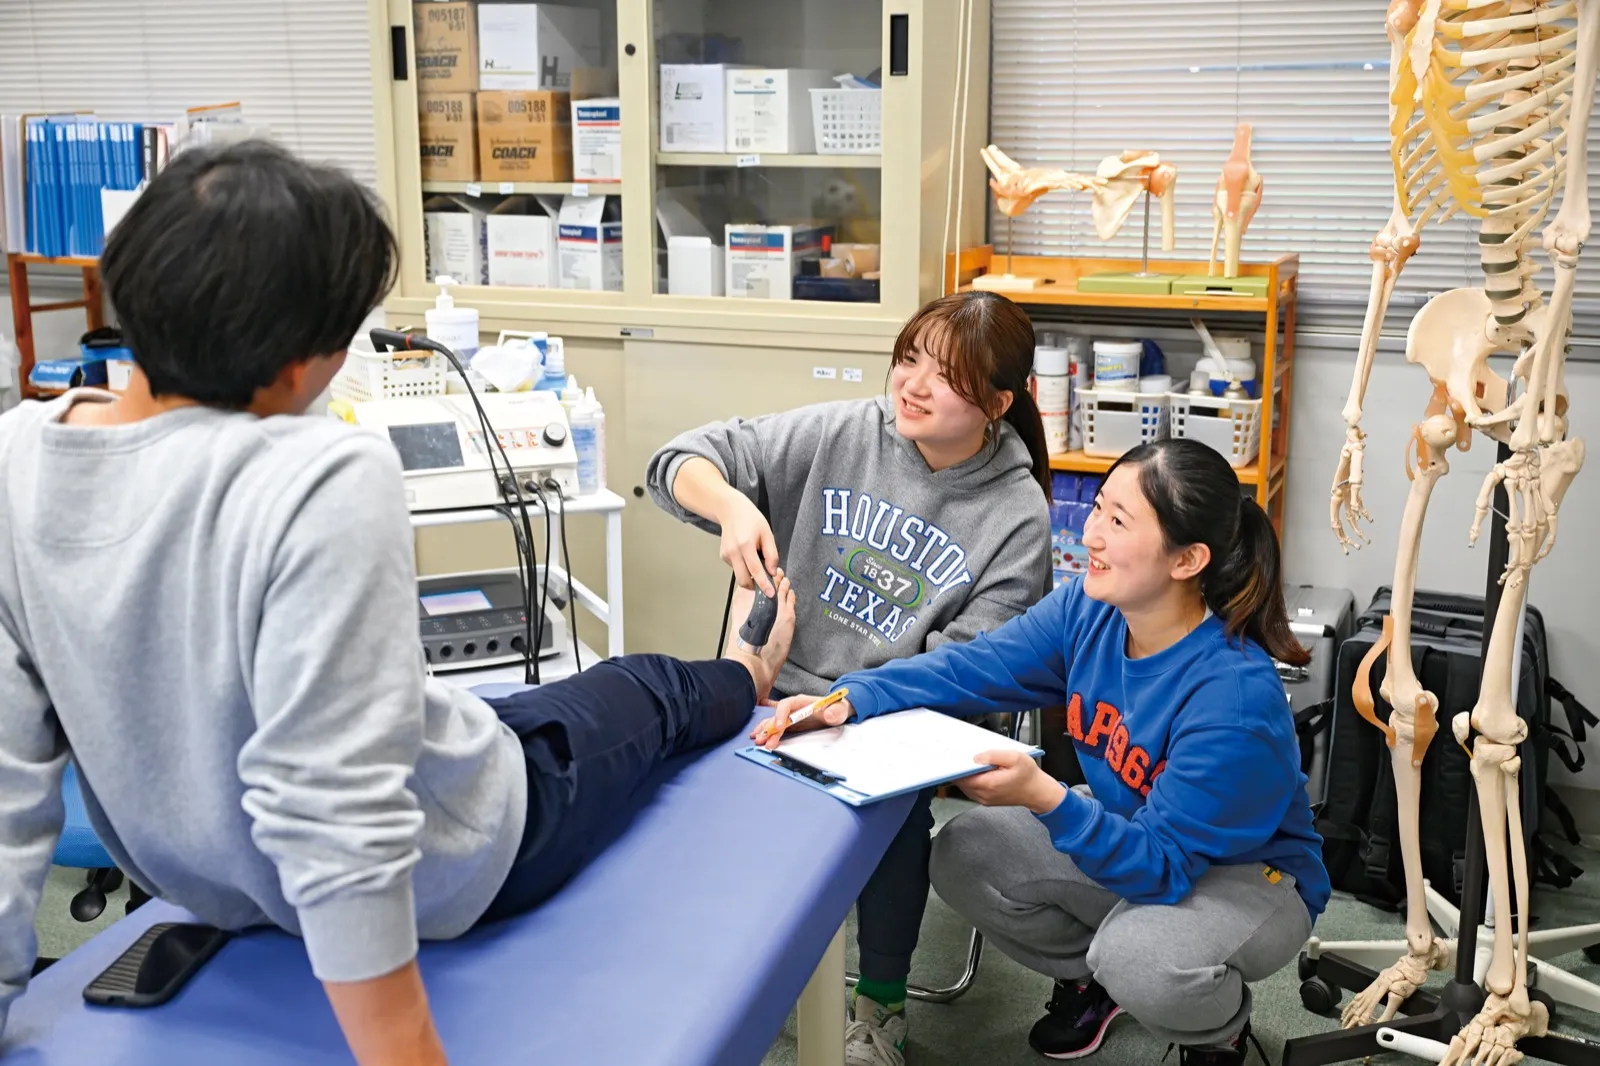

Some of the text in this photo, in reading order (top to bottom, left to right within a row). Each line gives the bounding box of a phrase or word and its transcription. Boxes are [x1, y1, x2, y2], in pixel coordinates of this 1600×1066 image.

[427, 100, 463, 113] 005188
[508, 99, 546, 113] 005188
[492, 146, 537, 160] COACH
[865, 556, 883, 570] Since
[863, 564, 912, 598] 1837
[819, 565, 917, 643] TEXAS
[828, 611, 849, 626] LONE
[850, 621, 868, 636] STAR
